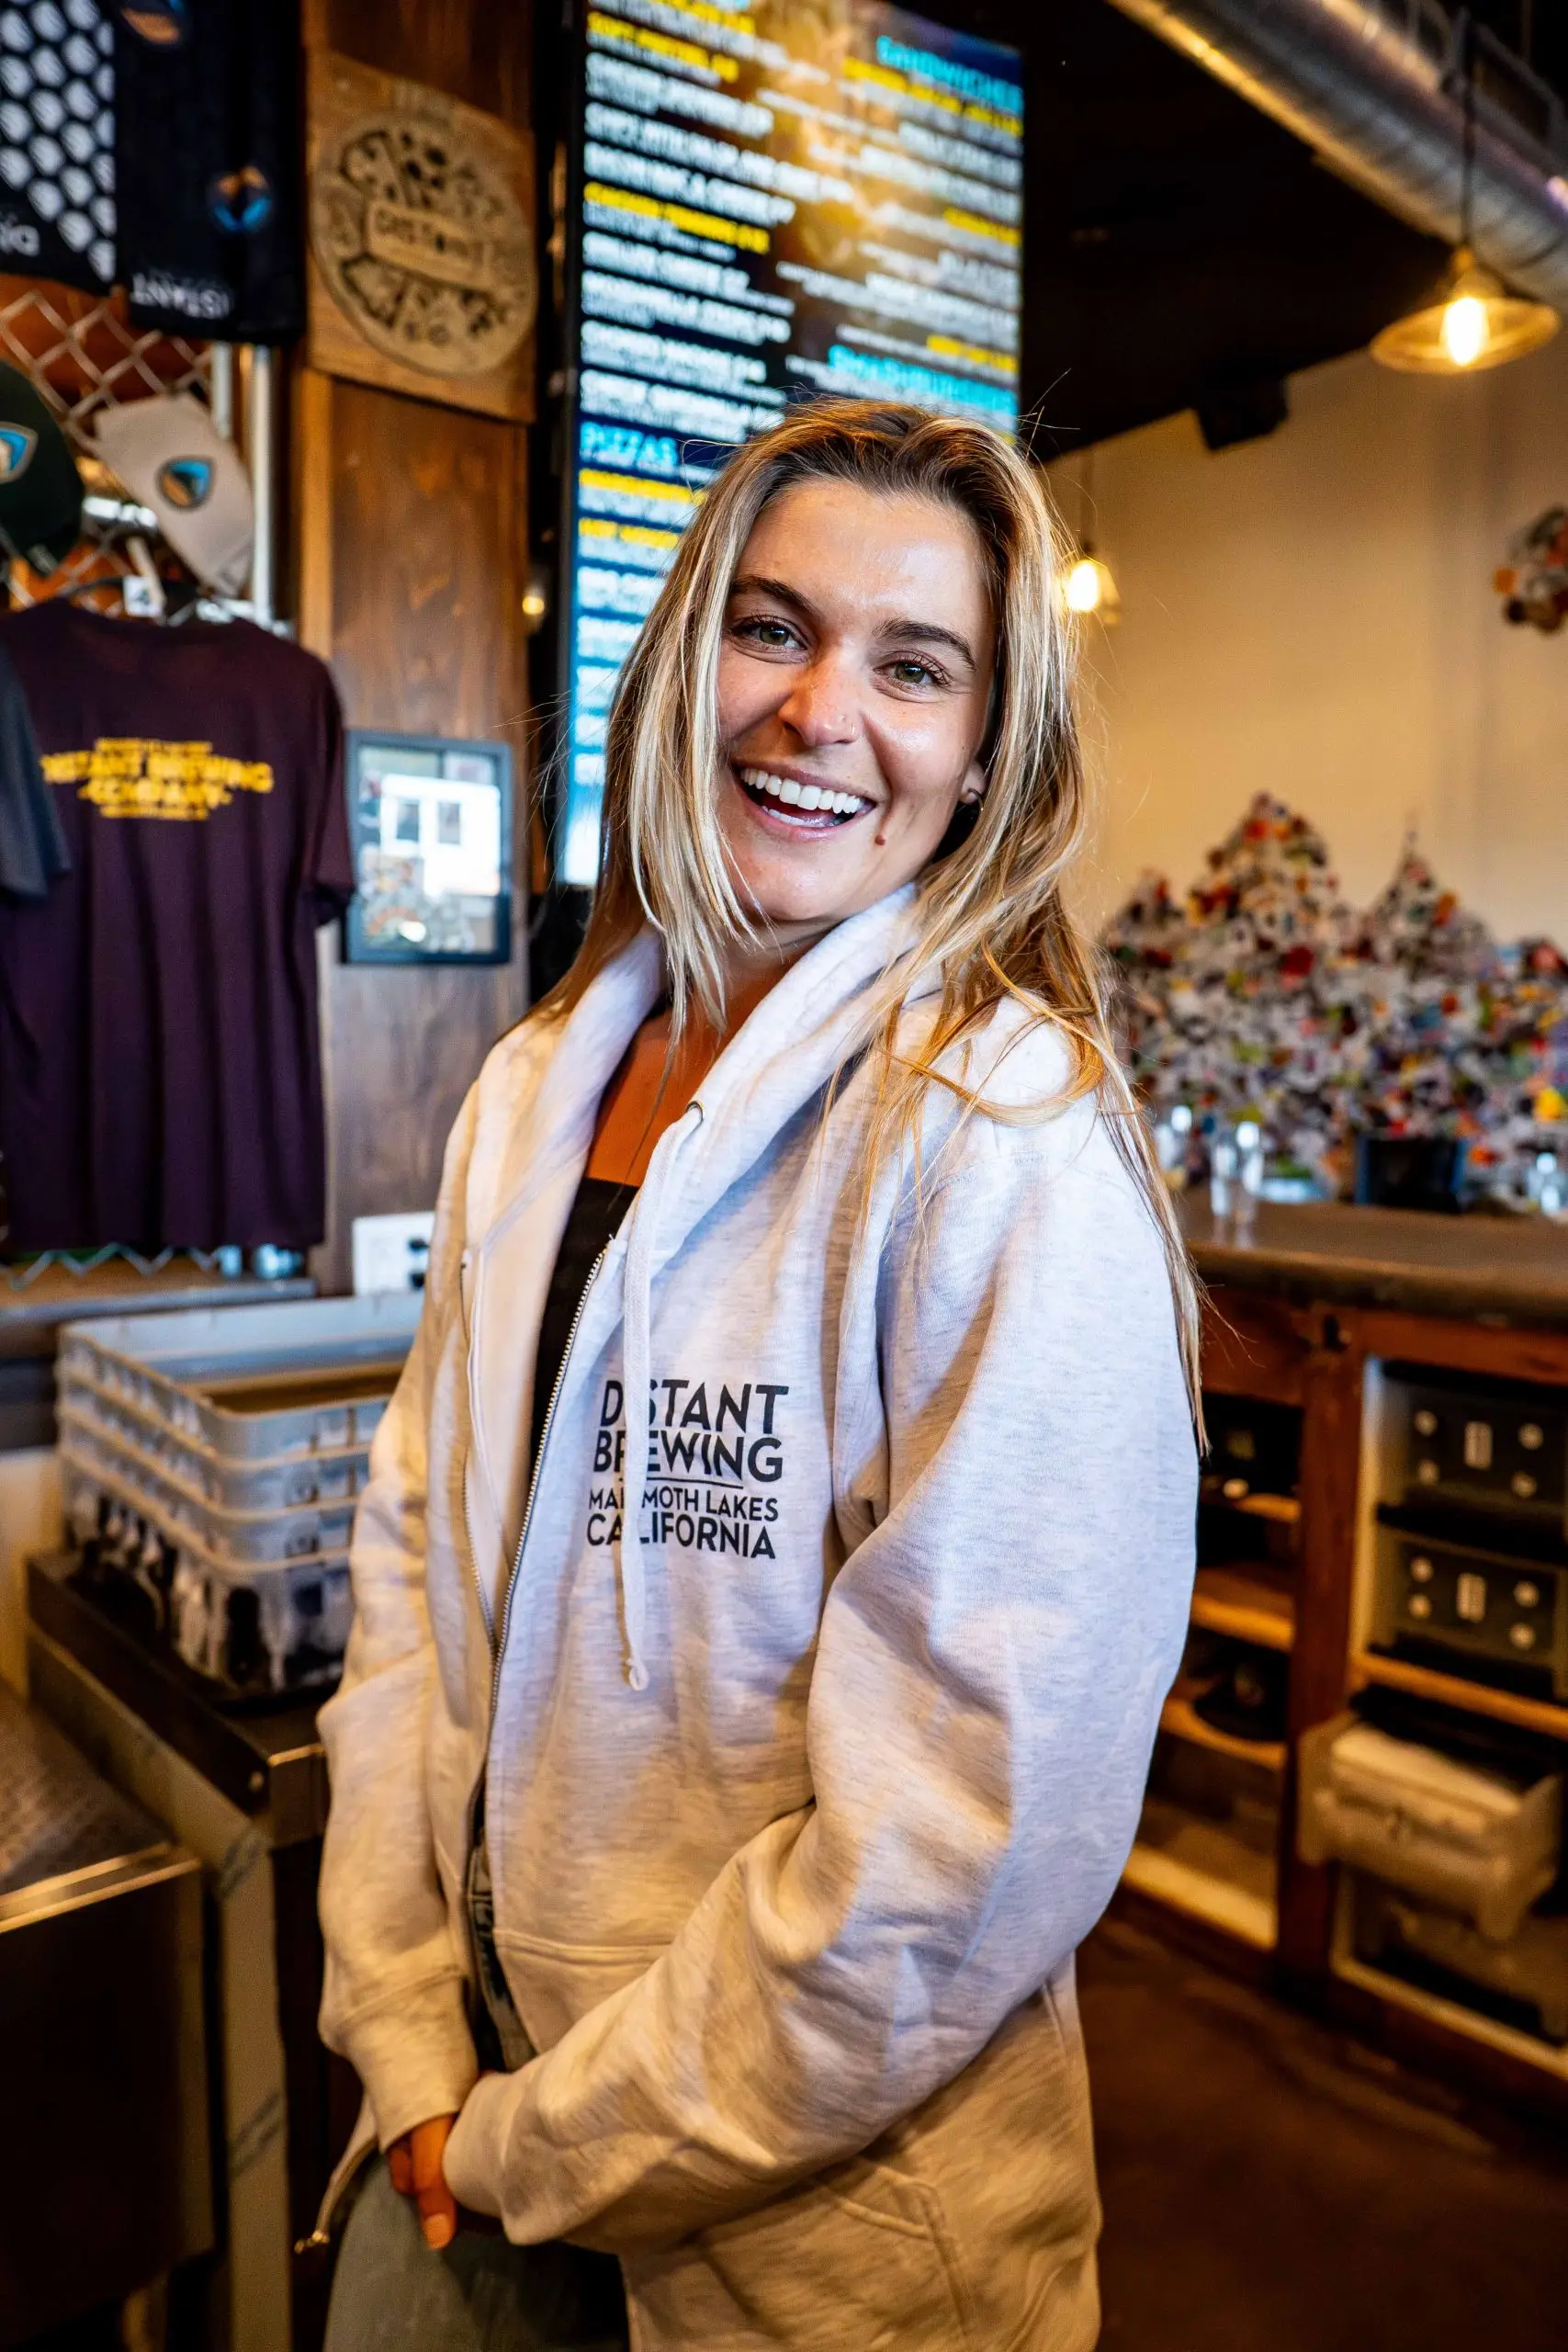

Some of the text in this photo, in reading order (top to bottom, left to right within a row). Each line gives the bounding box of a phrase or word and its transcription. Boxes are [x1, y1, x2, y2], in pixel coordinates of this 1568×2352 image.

[600, 1378, 789, 1434] DTANT
[588, 1485, 779, 1522] MAMOTH LAKES
